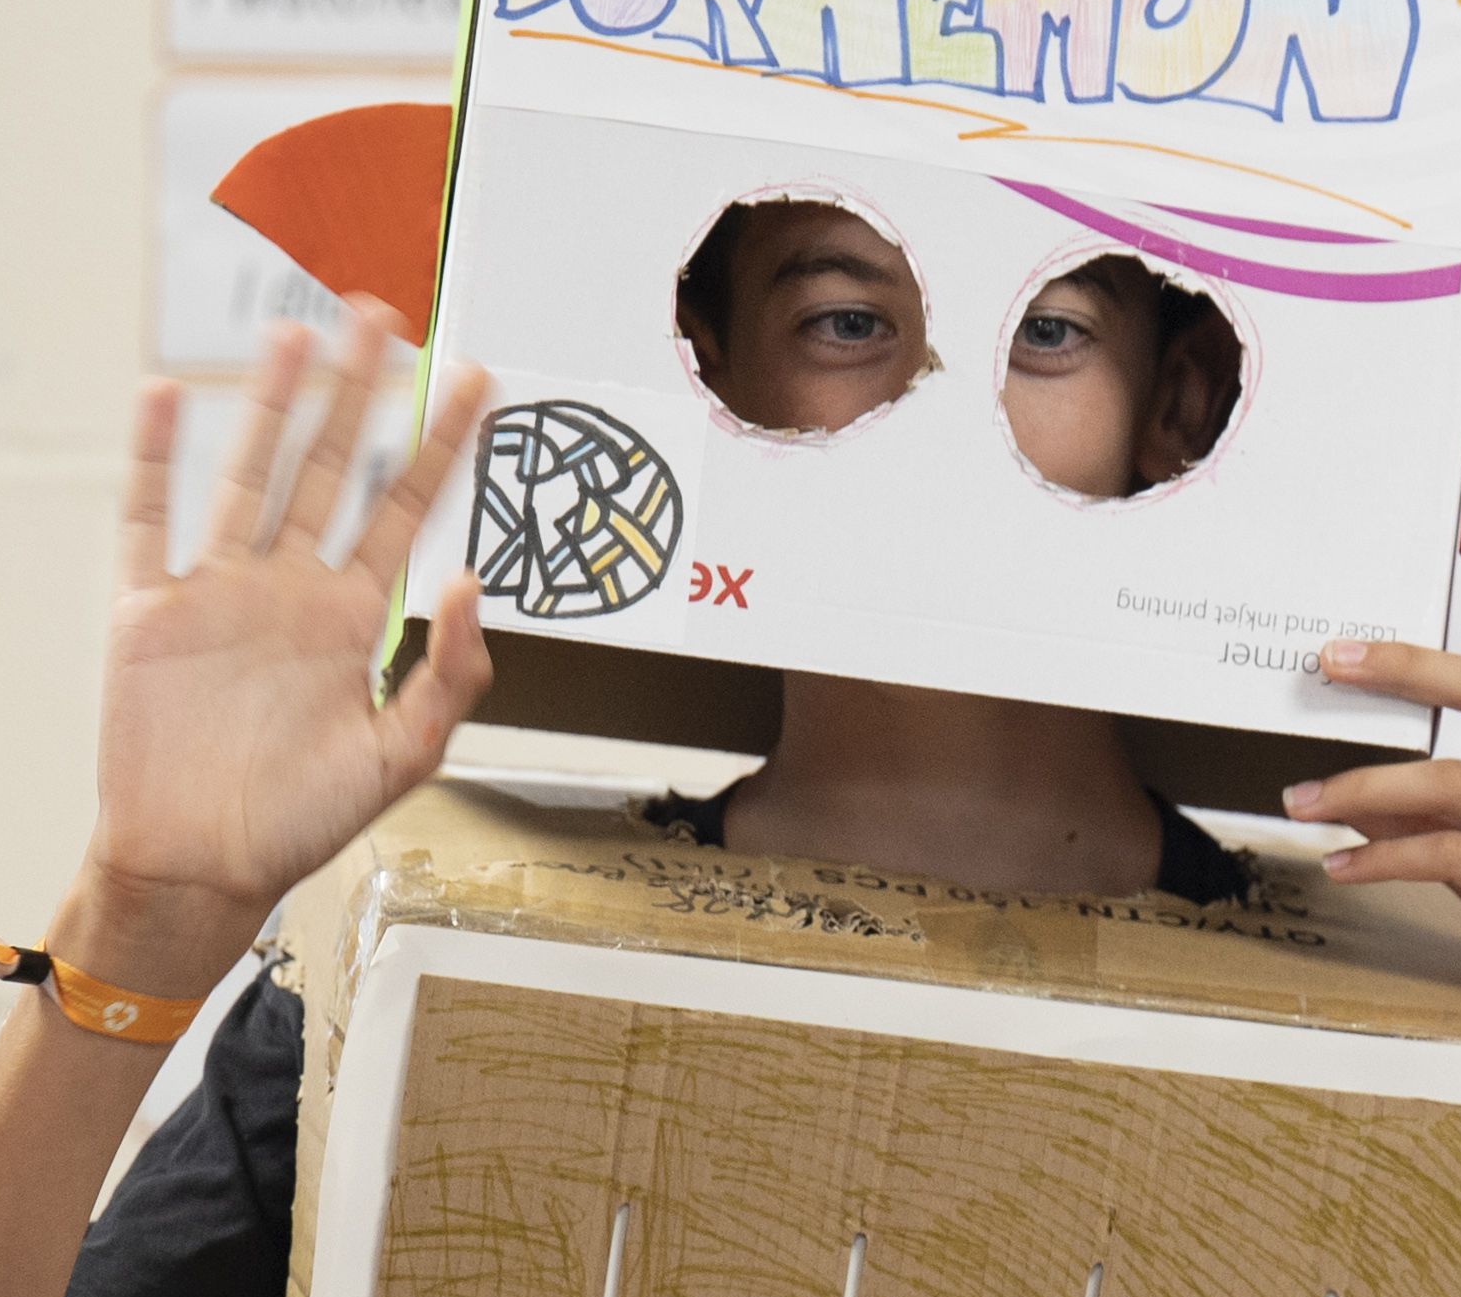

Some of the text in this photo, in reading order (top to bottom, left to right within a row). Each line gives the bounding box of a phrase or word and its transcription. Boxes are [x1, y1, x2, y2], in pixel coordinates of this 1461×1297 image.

[1115, 587, 1209, 622] printing
[1283, 612, 1331, 636] and
[1217, 640, 1333, 686] ormer
